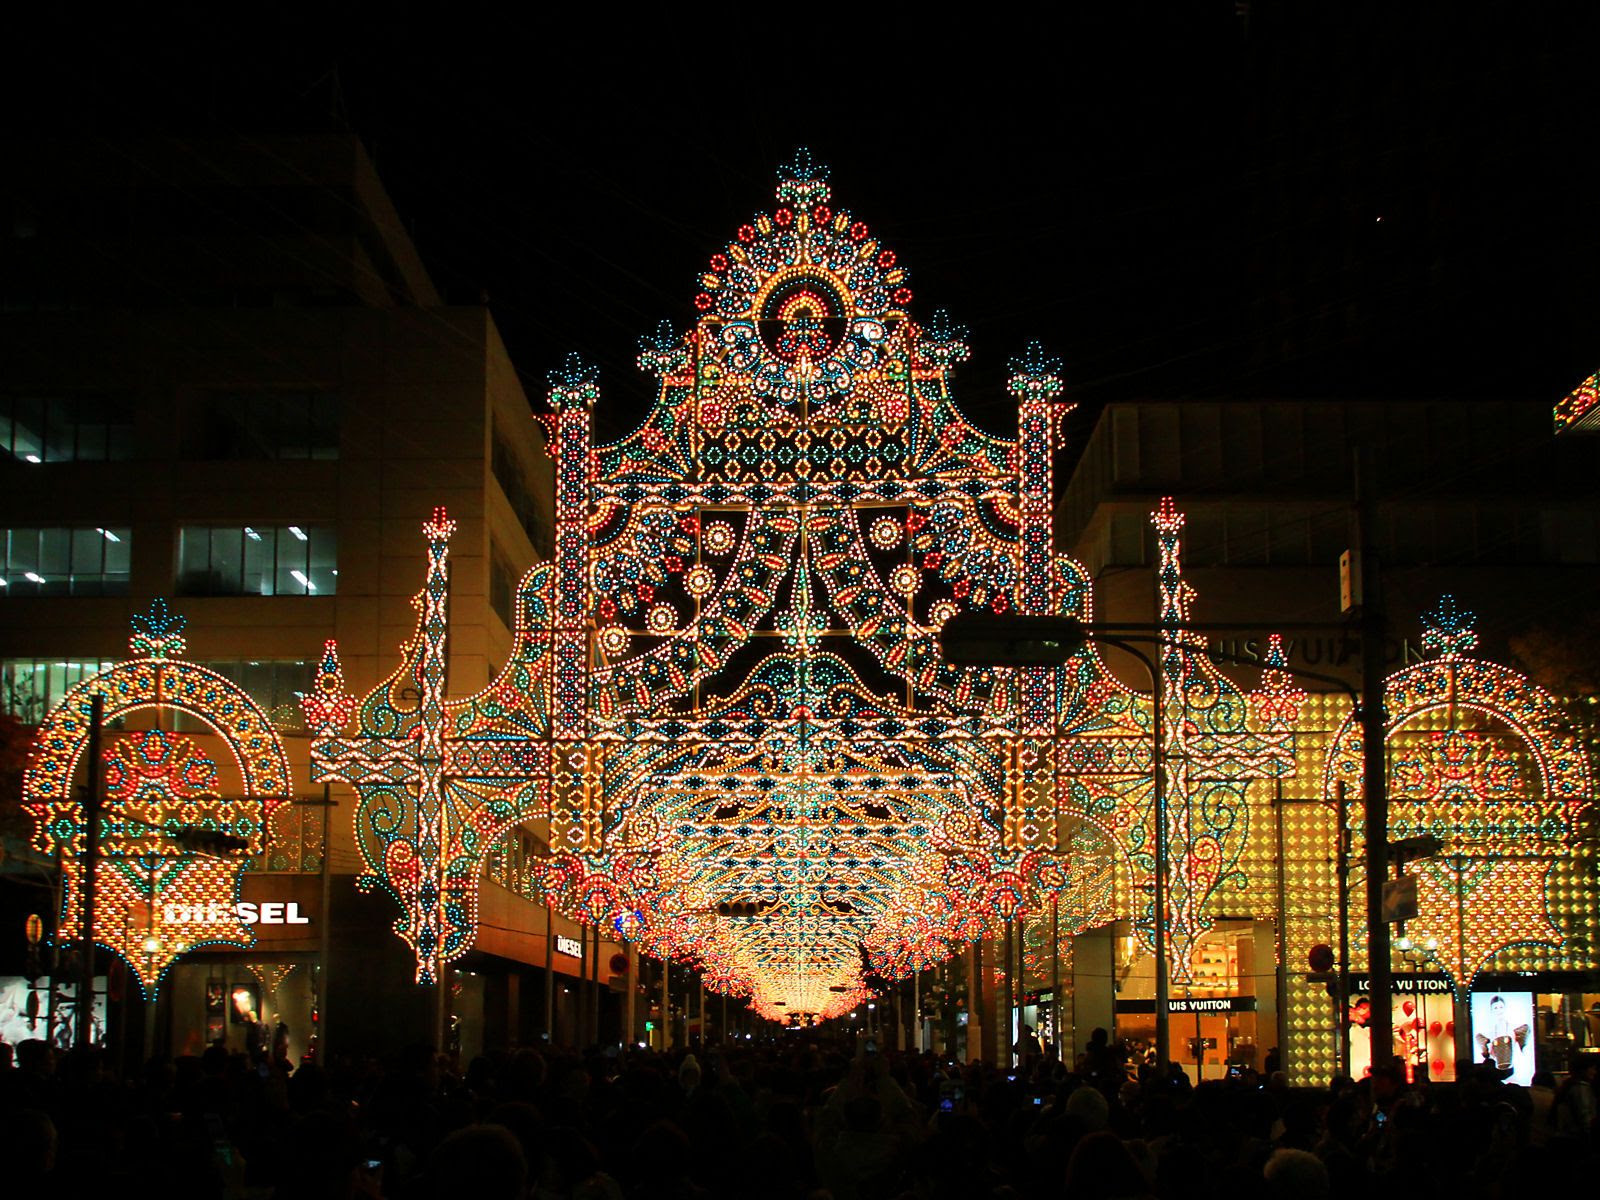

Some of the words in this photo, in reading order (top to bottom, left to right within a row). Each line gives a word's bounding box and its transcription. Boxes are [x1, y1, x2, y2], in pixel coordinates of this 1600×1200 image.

[163, 902, 309, 924] DIESEL
[557, 935, 583, 958] DIESEL
[1396, 980, 1448, 991] VUTTON
[1169, 1001, 1186, 1011] UIS
[1189, 1000, 1231, 1011] VUITTON
